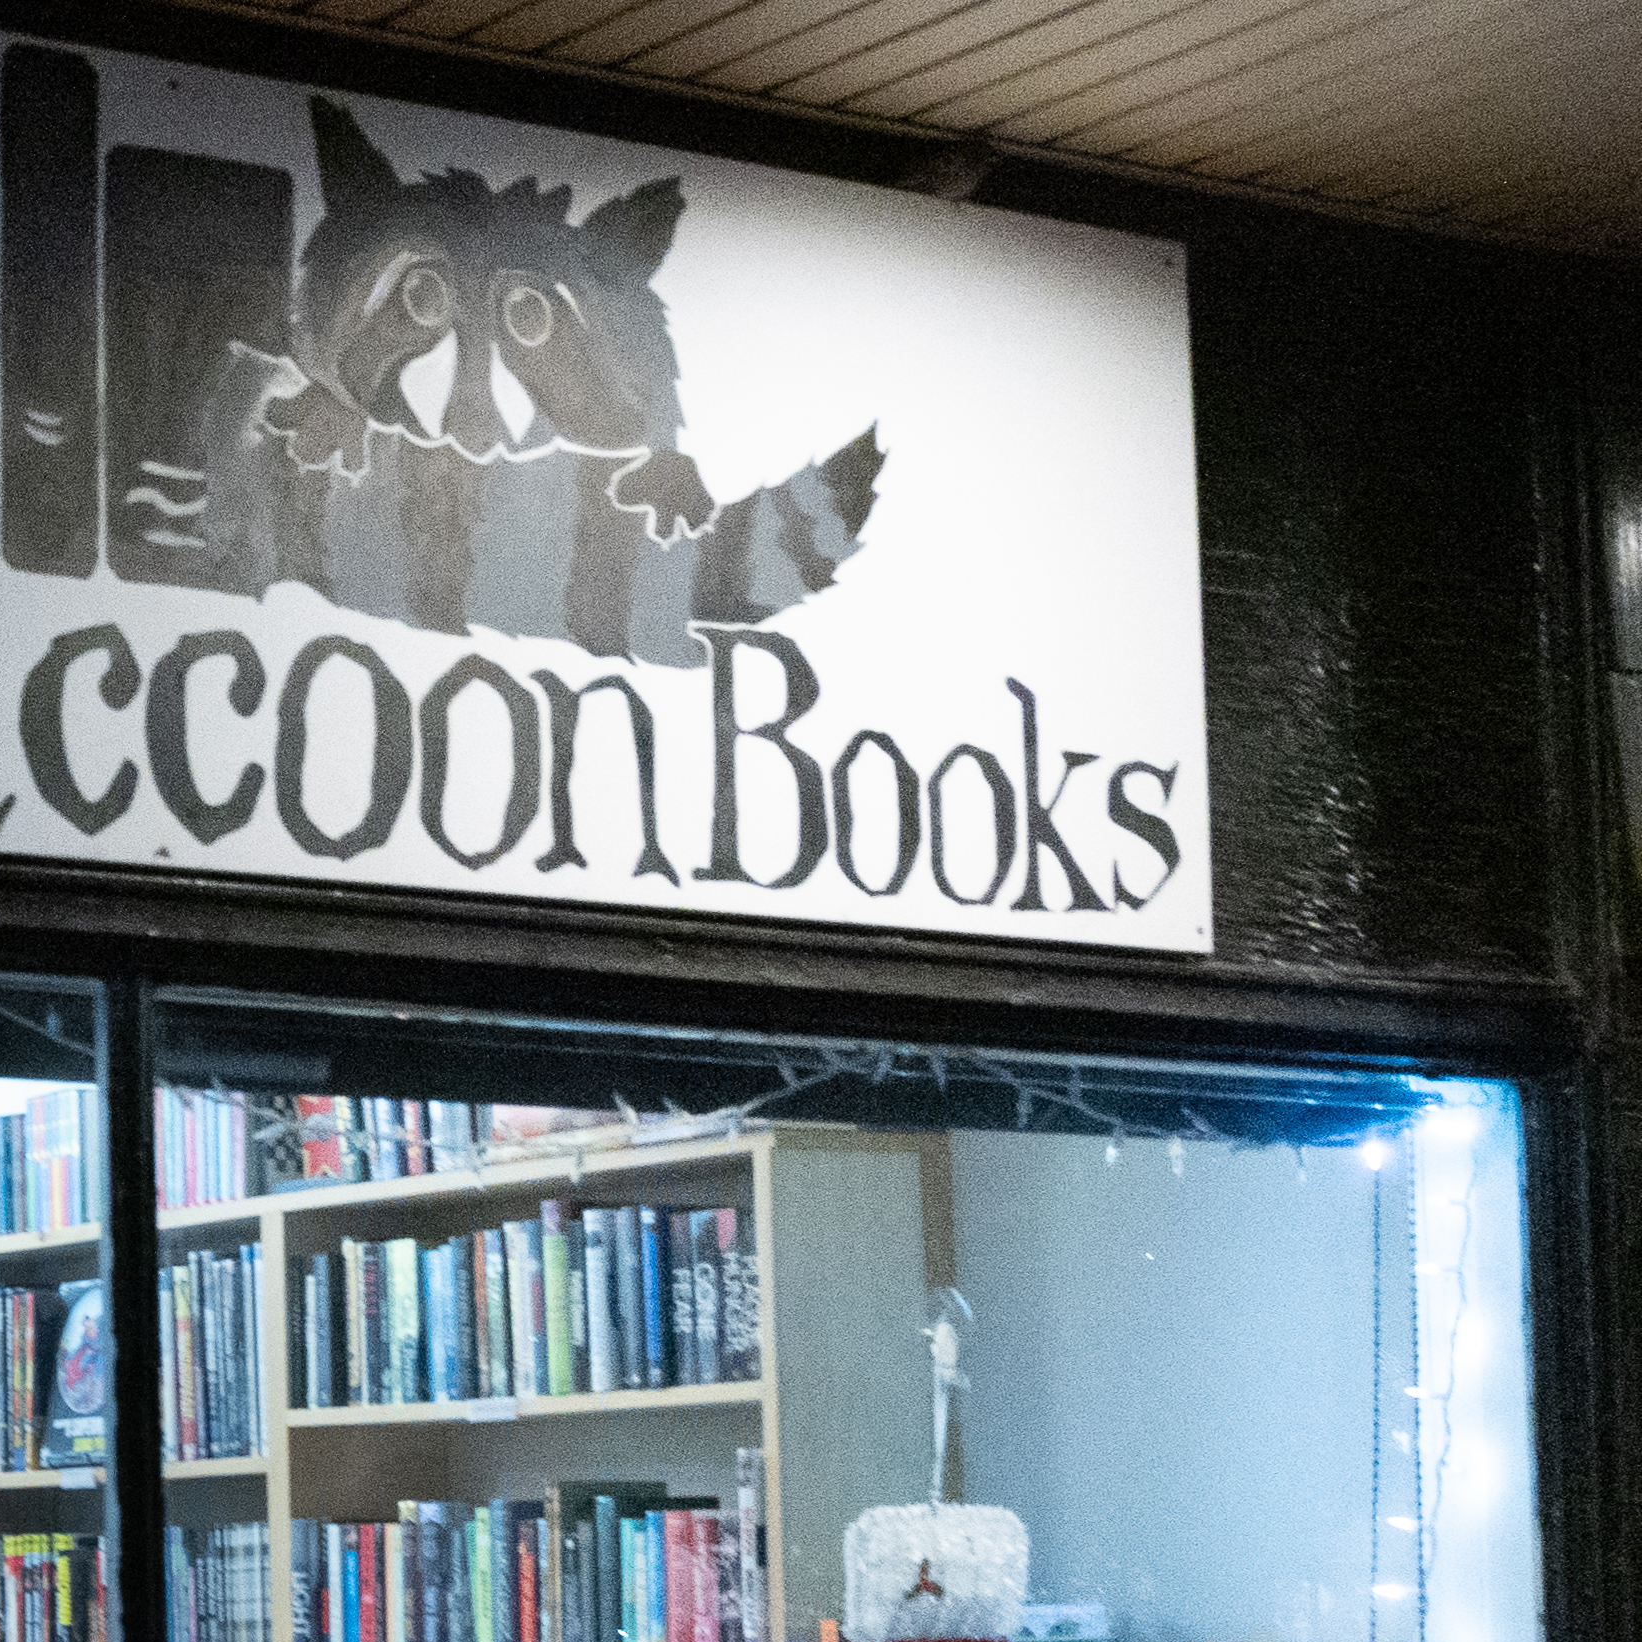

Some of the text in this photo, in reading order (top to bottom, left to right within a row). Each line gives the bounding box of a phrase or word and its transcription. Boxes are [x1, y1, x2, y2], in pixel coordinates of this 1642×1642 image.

[689, 621, 1181, 913] Books
[671, 1269, 693, 1333] FEAR
[695, 1262, 717, 1341] GONE
[292, 1570, 313, 1638] LIGHT
